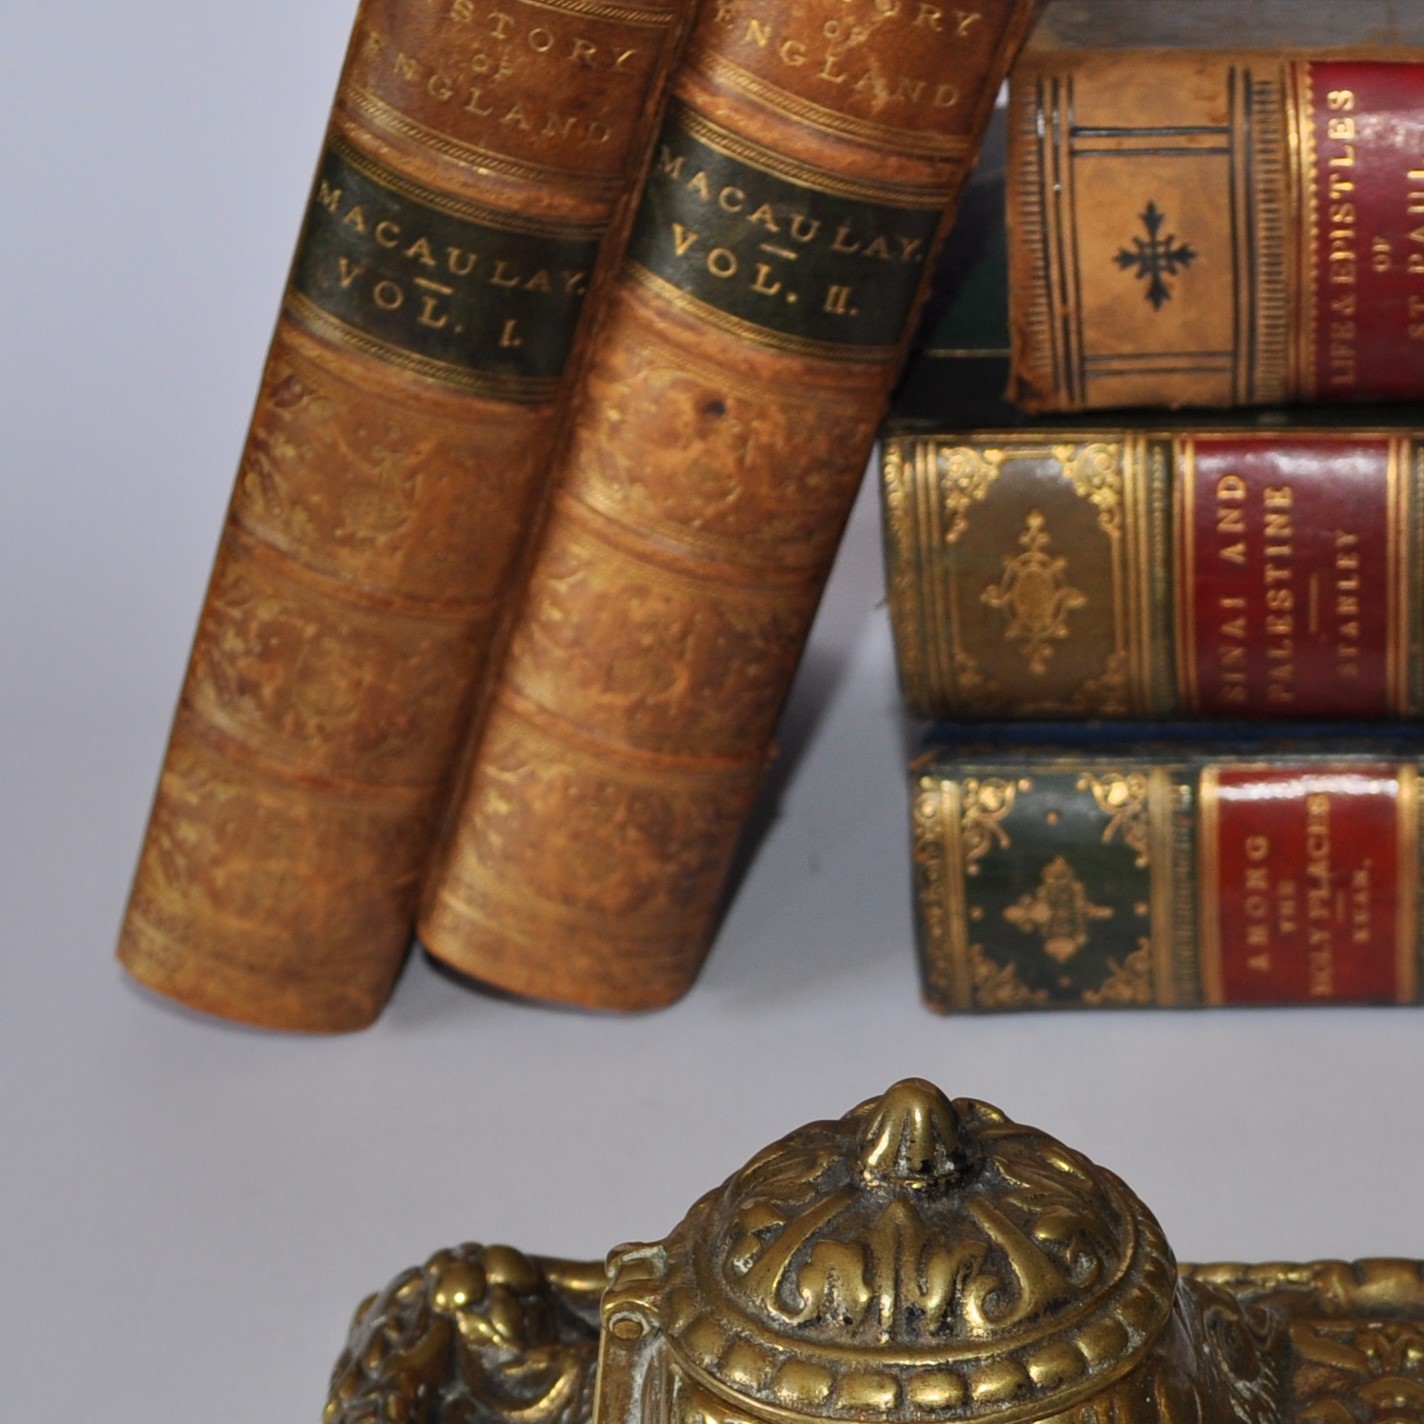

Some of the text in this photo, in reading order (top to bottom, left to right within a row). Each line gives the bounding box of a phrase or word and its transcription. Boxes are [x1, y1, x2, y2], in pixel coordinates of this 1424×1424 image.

[361, 30, 612, 145] ENGLAND
[444, 0, 638, 71] STORY
[713, 3, 960, 109] ENGLAND
[1327, 88, 1356, 284] EPISTLES
[337, 256, 466, 333] VOL.
[671, 222, 799, 304] VOL.
[1371, 235, 1393, 274] OF
[1215, 474, 1248, 704] SINAI AND
[1263, 485, 1295, 704] PALESTINE
[1334, 529, 1361, 679] STANLEY
[1244, 834, 1271, 974] AMONG
